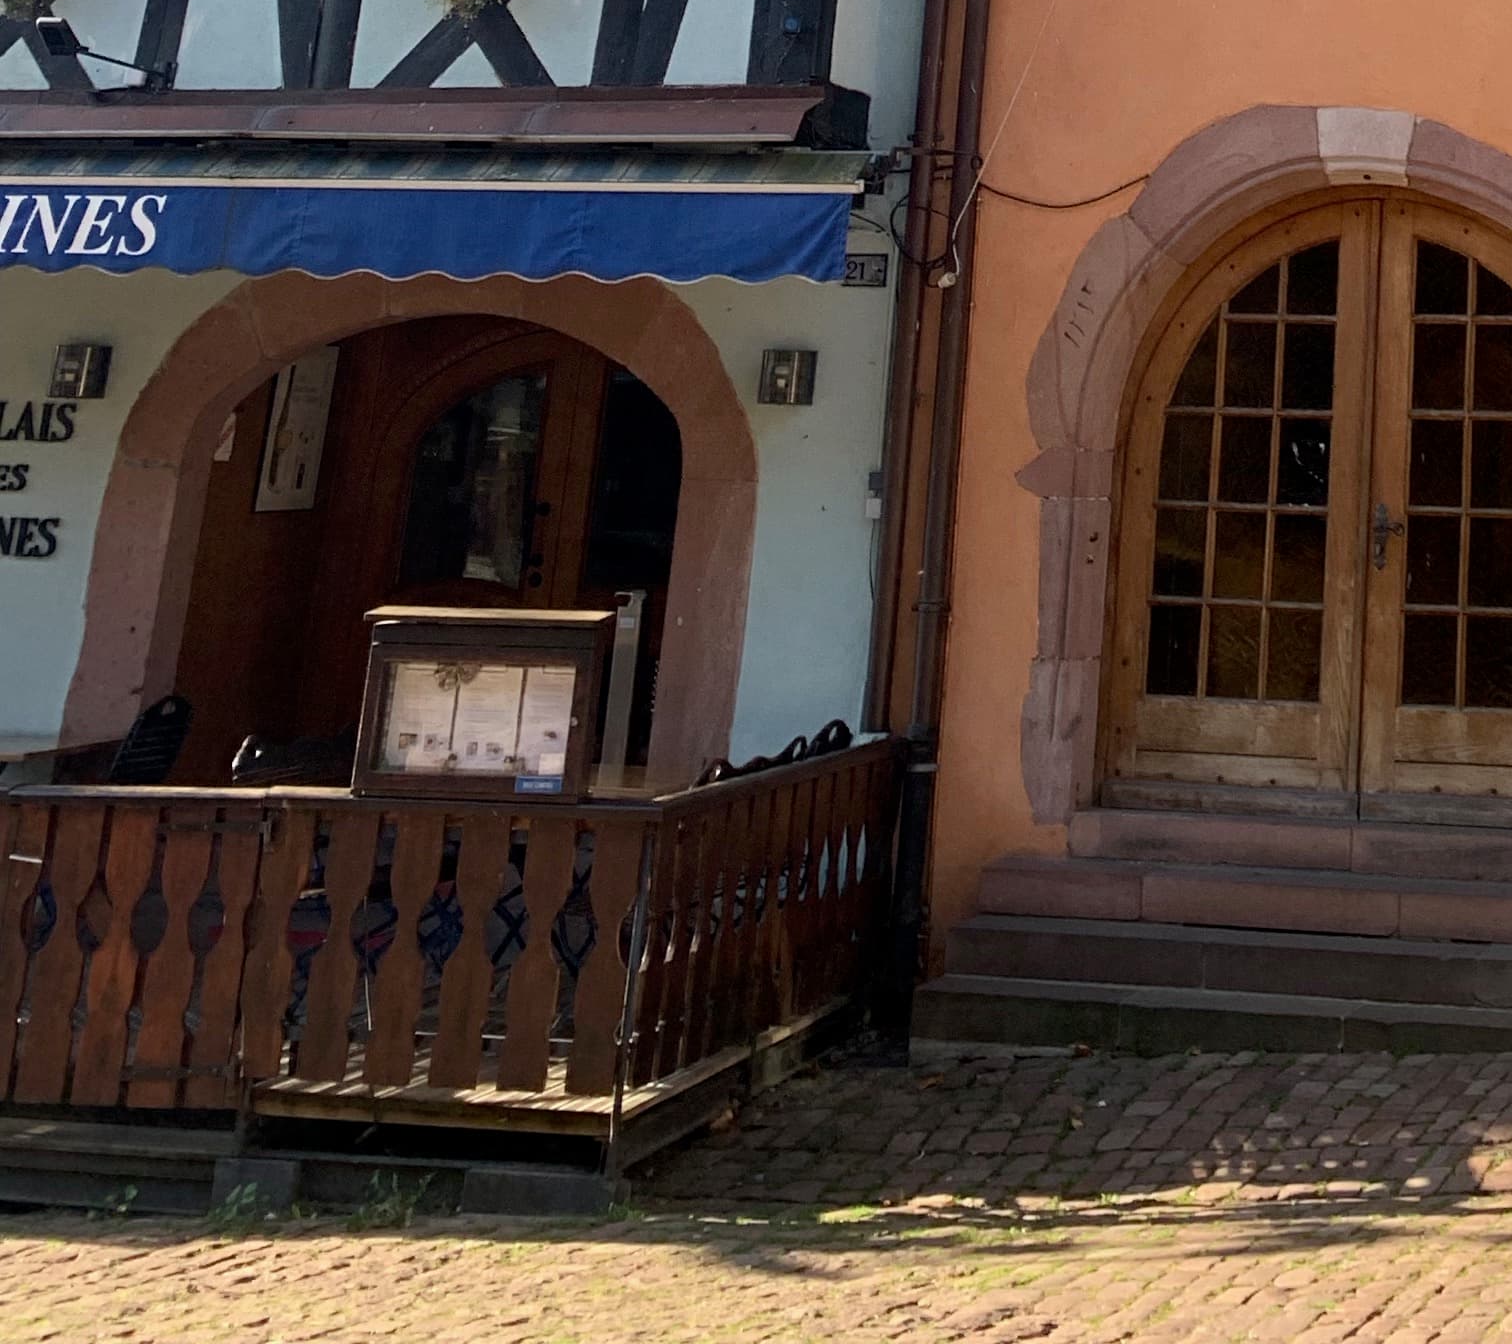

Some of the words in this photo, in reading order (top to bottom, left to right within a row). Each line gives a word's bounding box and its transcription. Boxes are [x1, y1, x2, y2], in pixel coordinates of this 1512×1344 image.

[0, 194, 168, 256] INES
[845, 260, 865, 281] 21
[0, 401, 77, 442] LAIS
